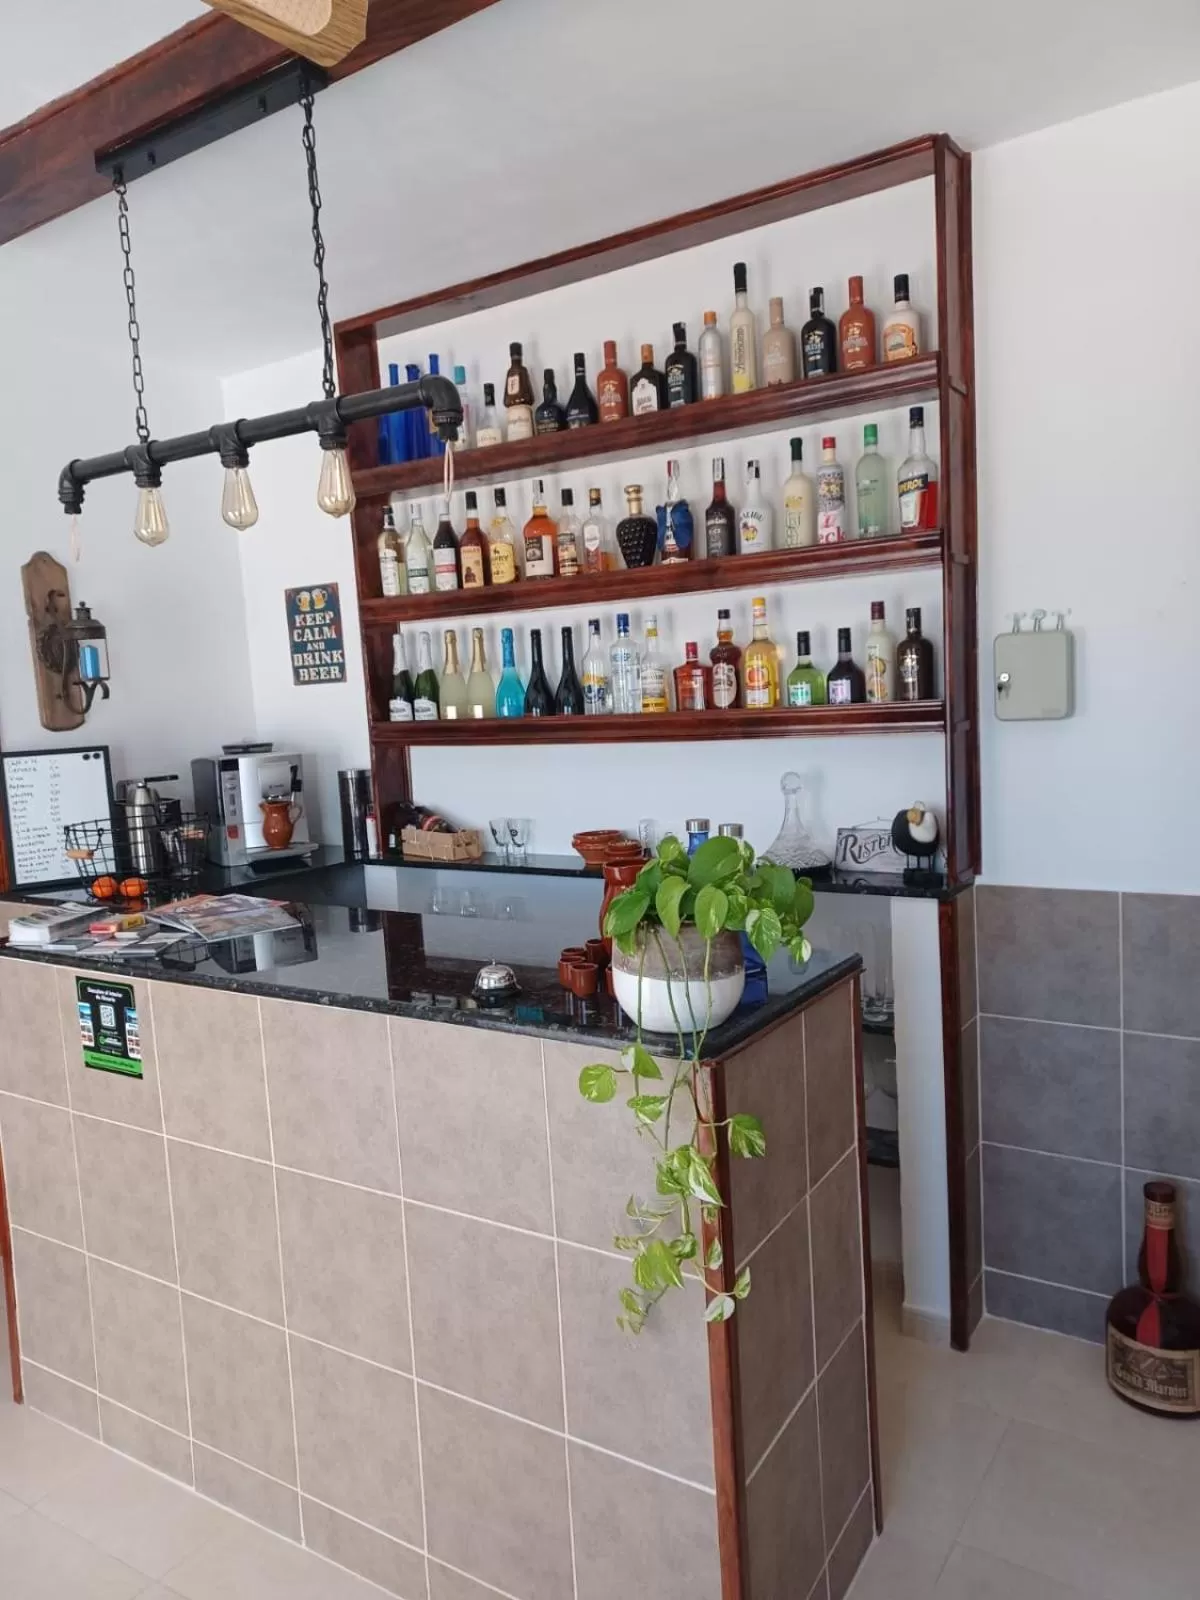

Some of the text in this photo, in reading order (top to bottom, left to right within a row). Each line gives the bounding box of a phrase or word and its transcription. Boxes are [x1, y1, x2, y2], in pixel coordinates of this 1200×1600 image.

[295, 611, 334, 627] KEEP
[293, 625, 337, 642] CALM
[306, 641, 325, 652] AND
[293, 650, 344, 667] DRINK
[298, 666, 342, 682] BEER
